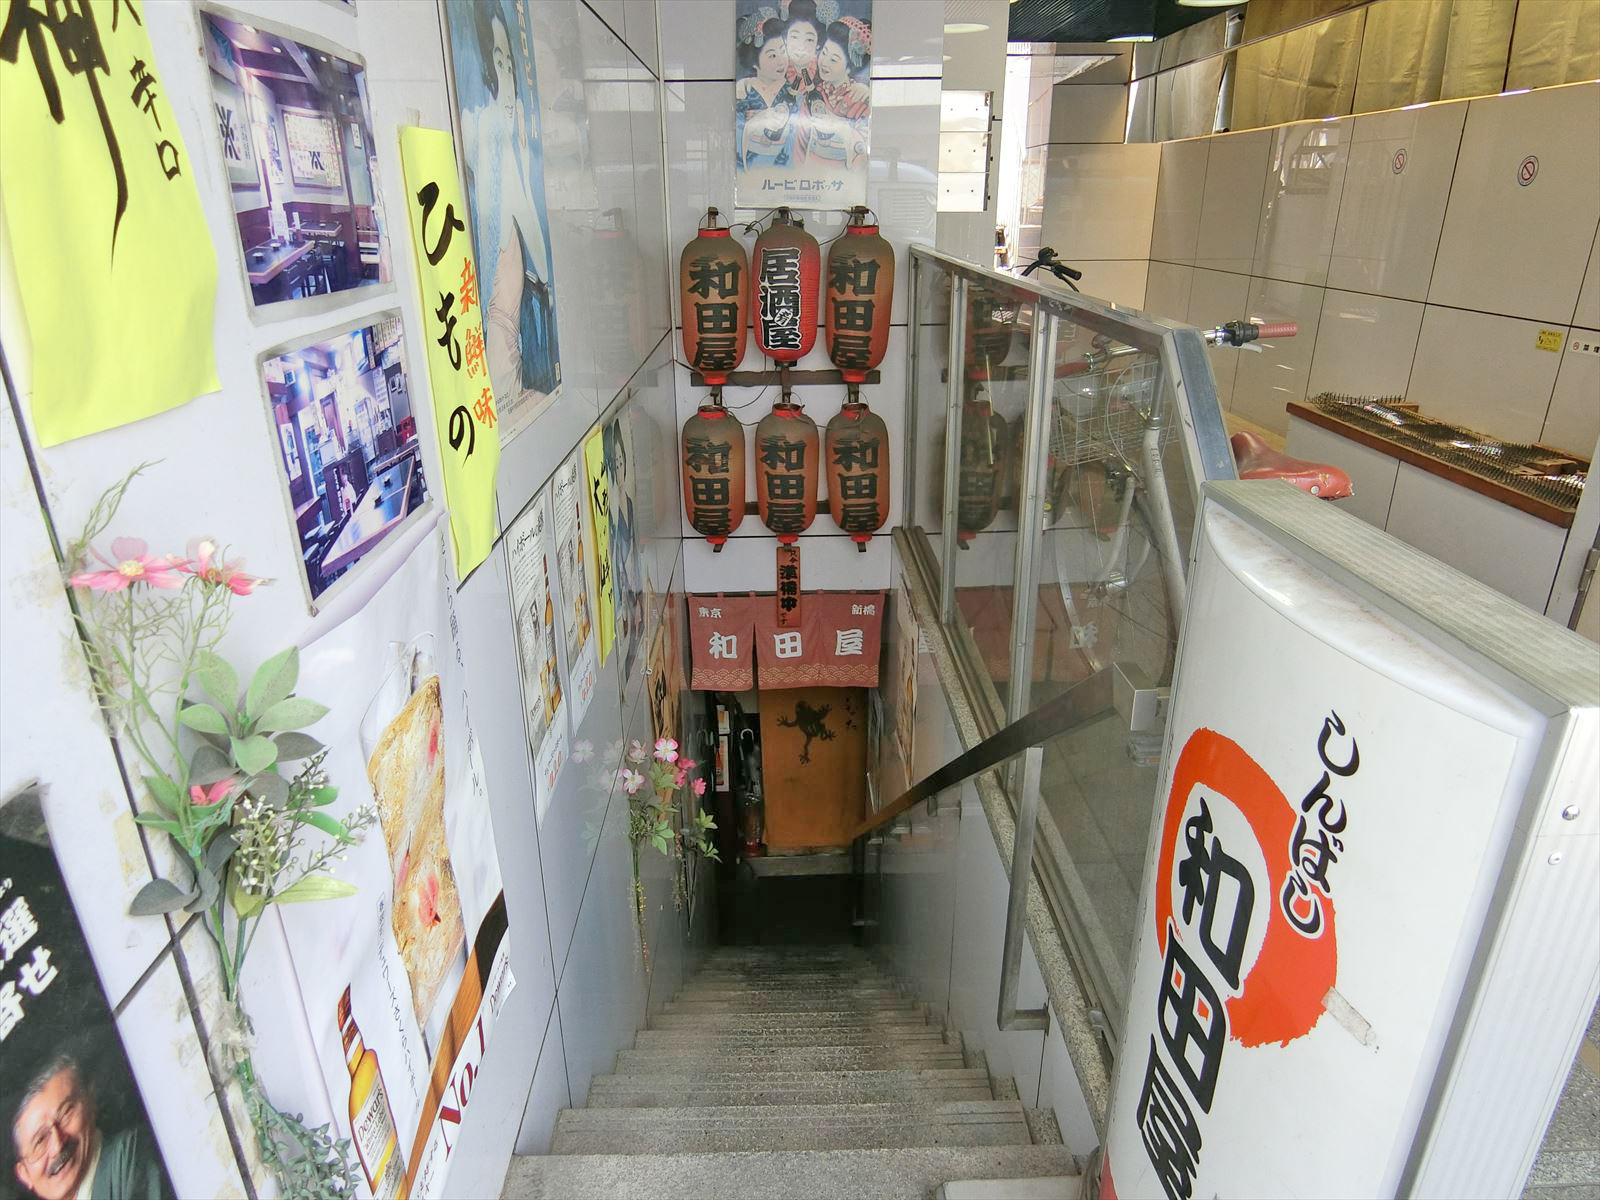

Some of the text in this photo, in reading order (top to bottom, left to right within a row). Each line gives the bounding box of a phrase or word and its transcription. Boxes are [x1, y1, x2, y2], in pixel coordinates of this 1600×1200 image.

[416, 181, 475, 470] ひもの
[688, 256, 741, 371] 和田屋
[758, 248, 801, 349] 居酒屋
[829, 254, 880, 370] 和田屋
[686, 436, 732, 535] 和田屋
[760, 435, 806, 535] 和田屋
[832, 437, 880, 534] 和田屋
[698, 607, 722, 618] 東京
[709, 629, 863, 660] 和田屋
[851, 604, 875, 616] 新橋
[1136, 797, 1254, 1200] 和田屋
[439, 1013, 486, 1162] No.1
